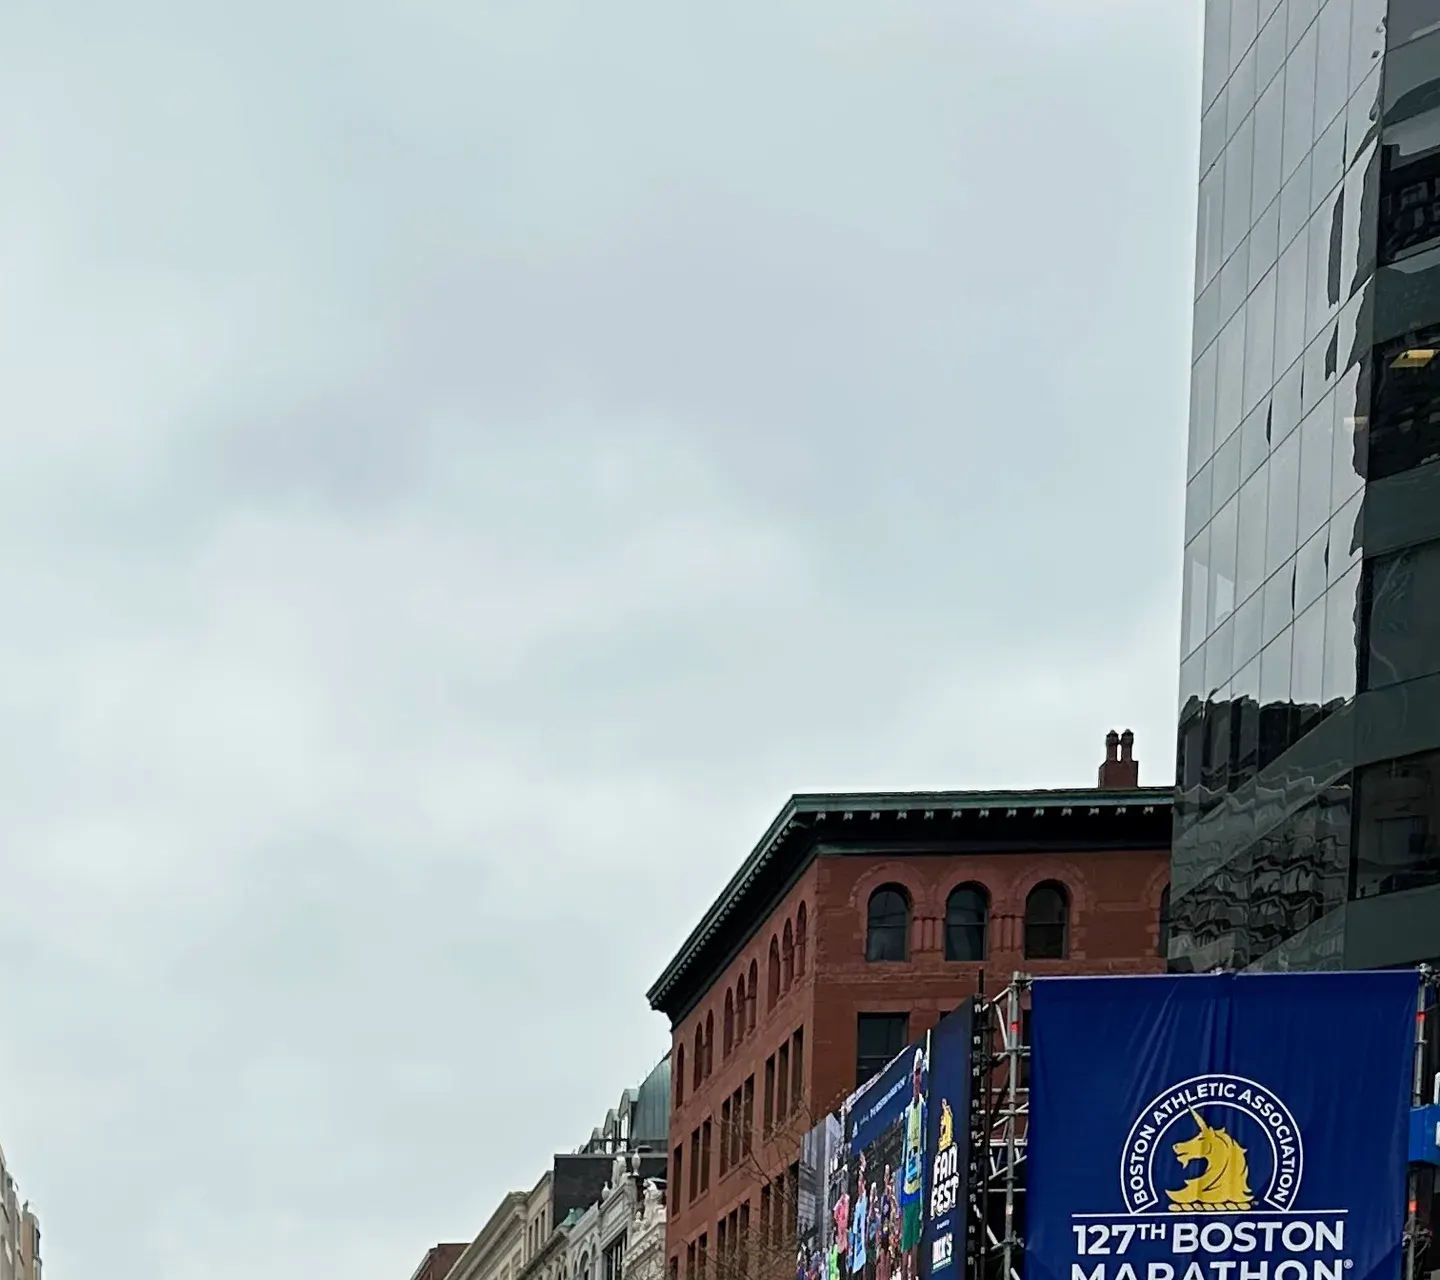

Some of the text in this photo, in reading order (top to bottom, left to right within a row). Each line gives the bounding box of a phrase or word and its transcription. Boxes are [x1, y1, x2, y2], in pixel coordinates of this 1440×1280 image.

[933, 1143, 959, 1182] FAN
[1129, 1082, 1296, 1205] BOSTON ATHLETIC ASSOCIATION
[930, 1174, 960, 1220] FEST
[1072, 1220, 1345, 1255] 127TH BOSTON
